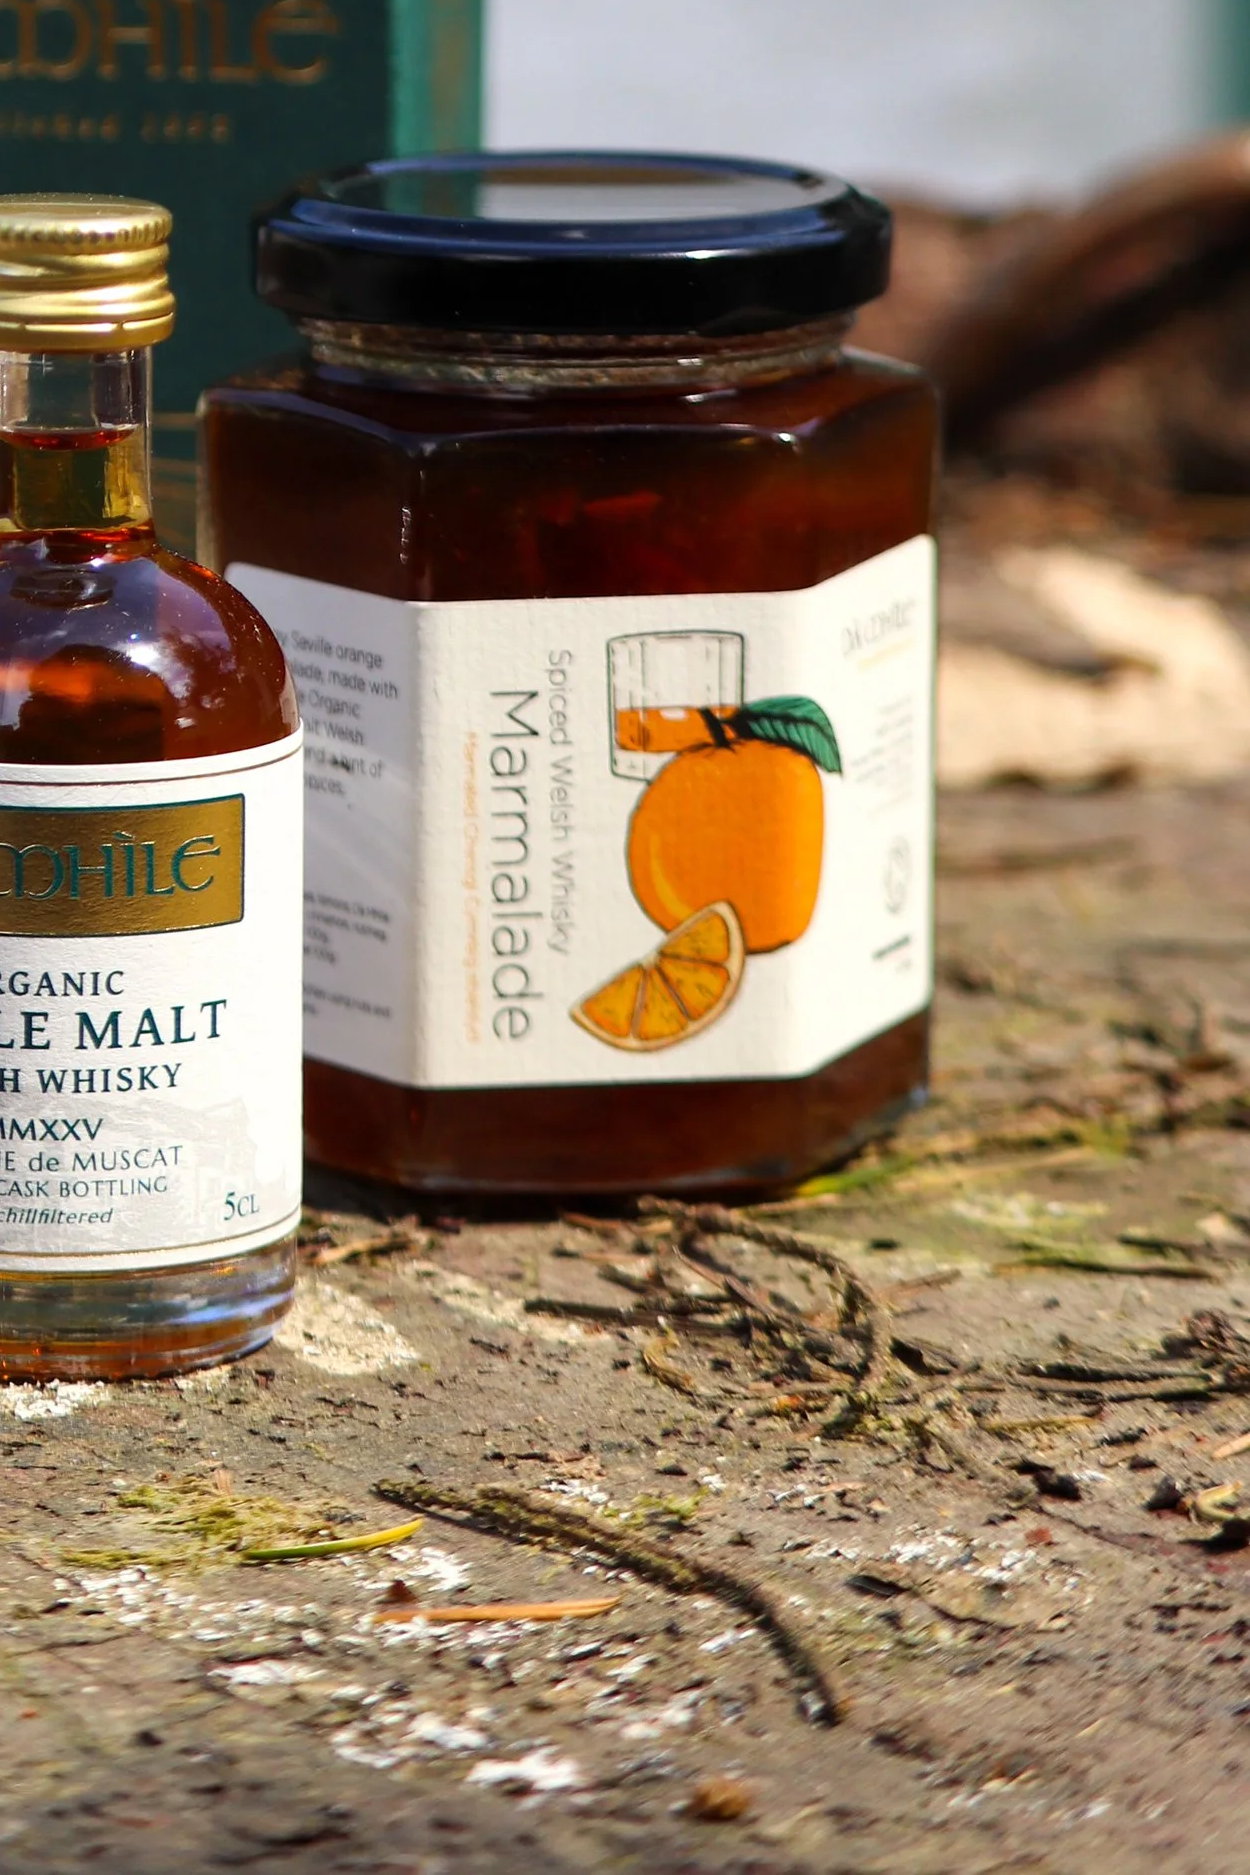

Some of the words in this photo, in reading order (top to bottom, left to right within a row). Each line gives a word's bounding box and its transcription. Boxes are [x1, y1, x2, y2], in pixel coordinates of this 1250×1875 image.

[335, 644, 383, 670] orange
[308, 688, 361, 719] Organic
[369, 676, 398, 700] with
[545, 648, 574, 747] Spiced
[549, 755, 574, 841] Welsh
[489, 689, 544, 1041] Marmalade
[548, 849, 574, 956] Whisky
[74, 998, 228, 1051] MALT
[35, 1062, 183, 1094] WHISKY
[28, 1151, 60, 1173] de
[71, 1144, 184, 1172] MUSCAT
[59, 1175, 169, 1198] BOTTLING
